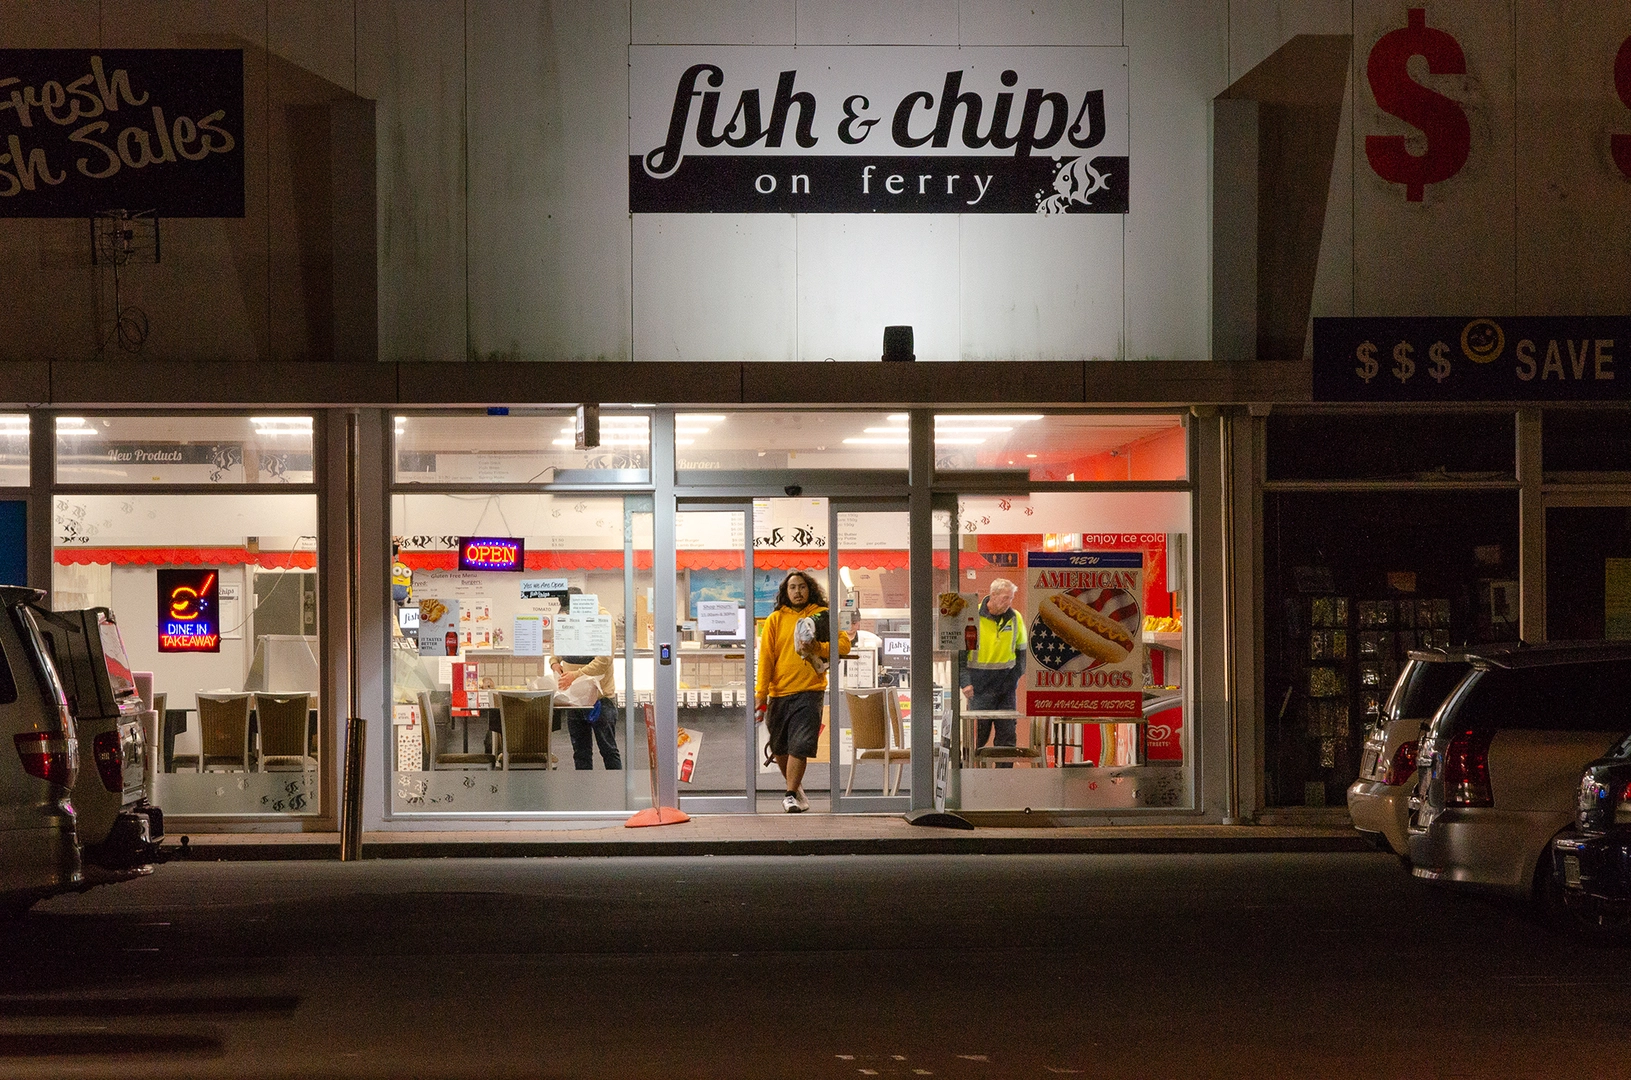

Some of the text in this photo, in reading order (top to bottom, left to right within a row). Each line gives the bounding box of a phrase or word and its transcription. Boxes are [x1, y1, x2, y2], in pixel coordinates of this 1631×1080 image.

[643, 63, 1107, 178] fish & chips
[68, 106, 235, 179] Sales
[754, 165, 994, 204] on ferry
[1515, 338, 1615, 382] SAVE
[107, 449, 182, 461] New Products
[1086, 533, 1165, 545] enjoy ice cold
[466, 546, 516, 563] OPEN
[1069, 556, 1100, 565] NEW
[1034, 569, 1138, 590] AMERICAN
[168, 623, 207, 635] DINE IN
[162, 635, 217, 647] TAKEAWAY
[1035, 670, 1134, 688] HOT DOGS
[1034, 700, 1136, 709] NOW AVAILABLE INSTORE
